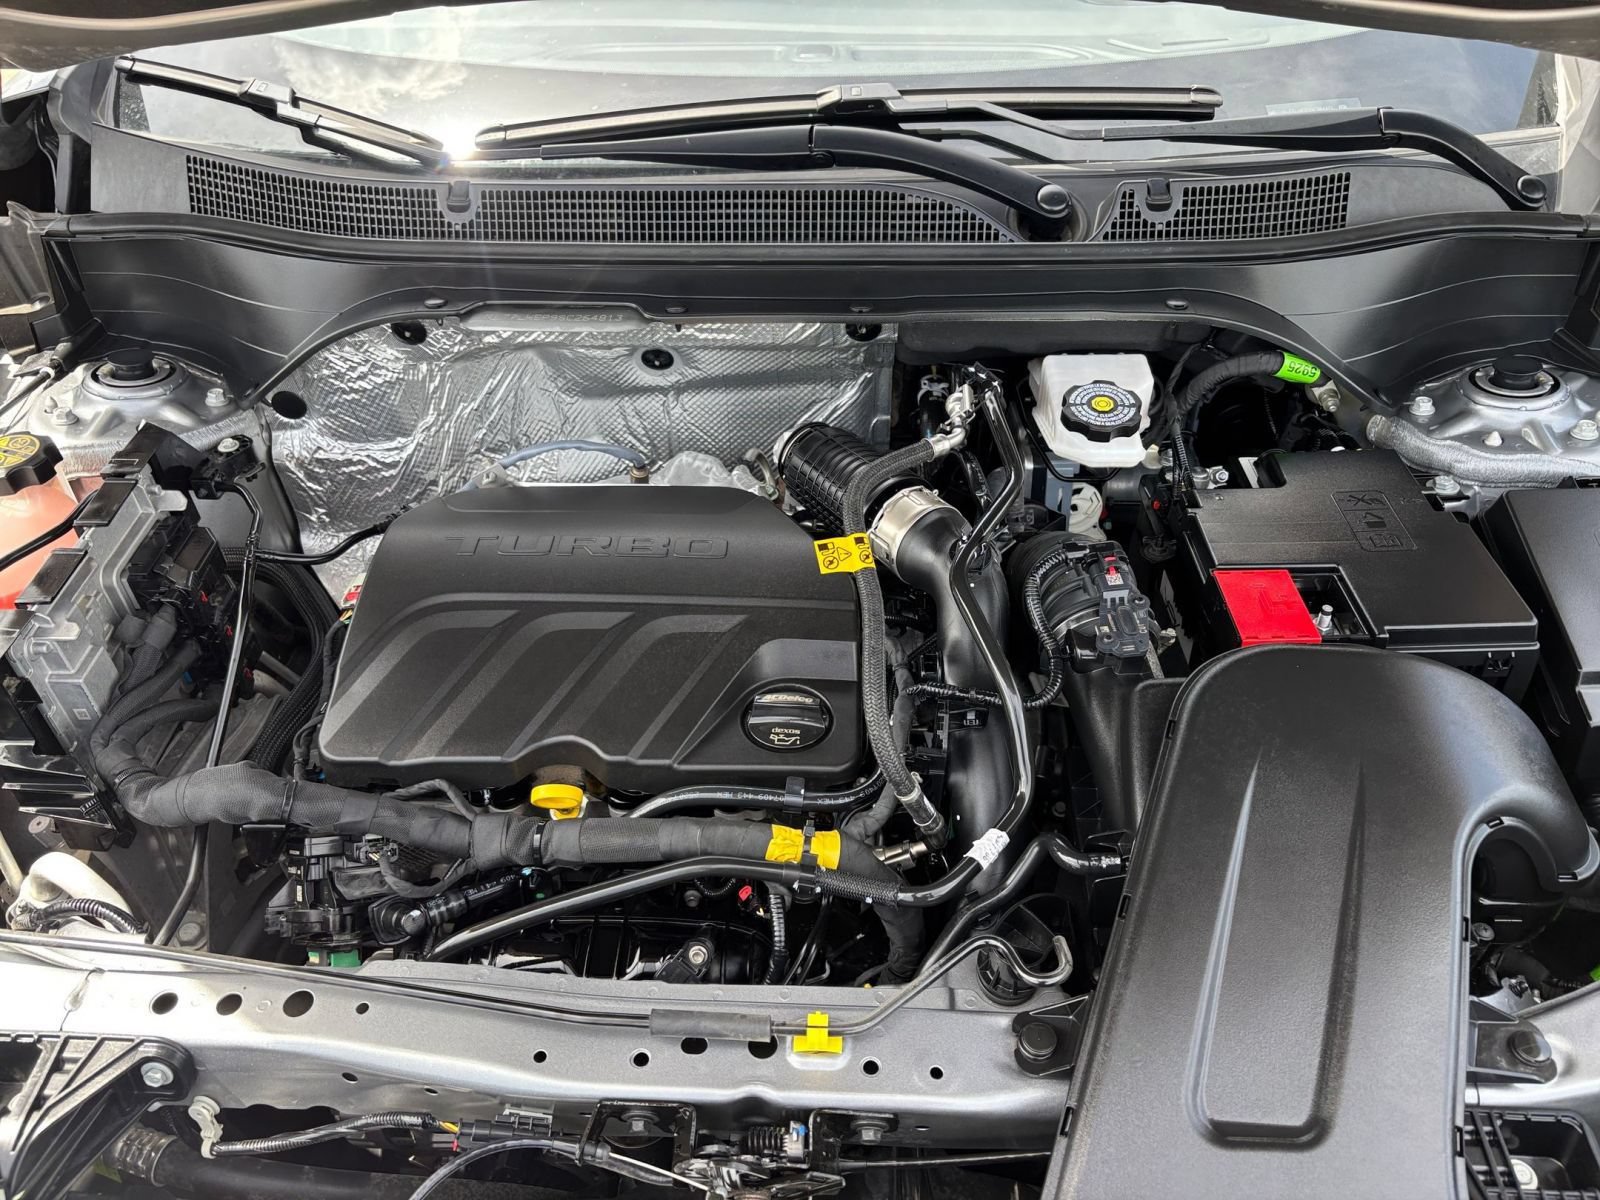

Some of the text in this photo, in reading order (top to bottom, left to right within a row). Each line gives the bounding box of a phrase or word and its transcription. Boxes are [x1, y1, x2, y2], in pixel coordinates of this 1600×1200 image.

[1287, 361, 1318, 378] 5925
[445, 534, 729, 560] TURBO
[761, 693, 814, 703] ACDelco
[771, 726, 801, 735] dexos
